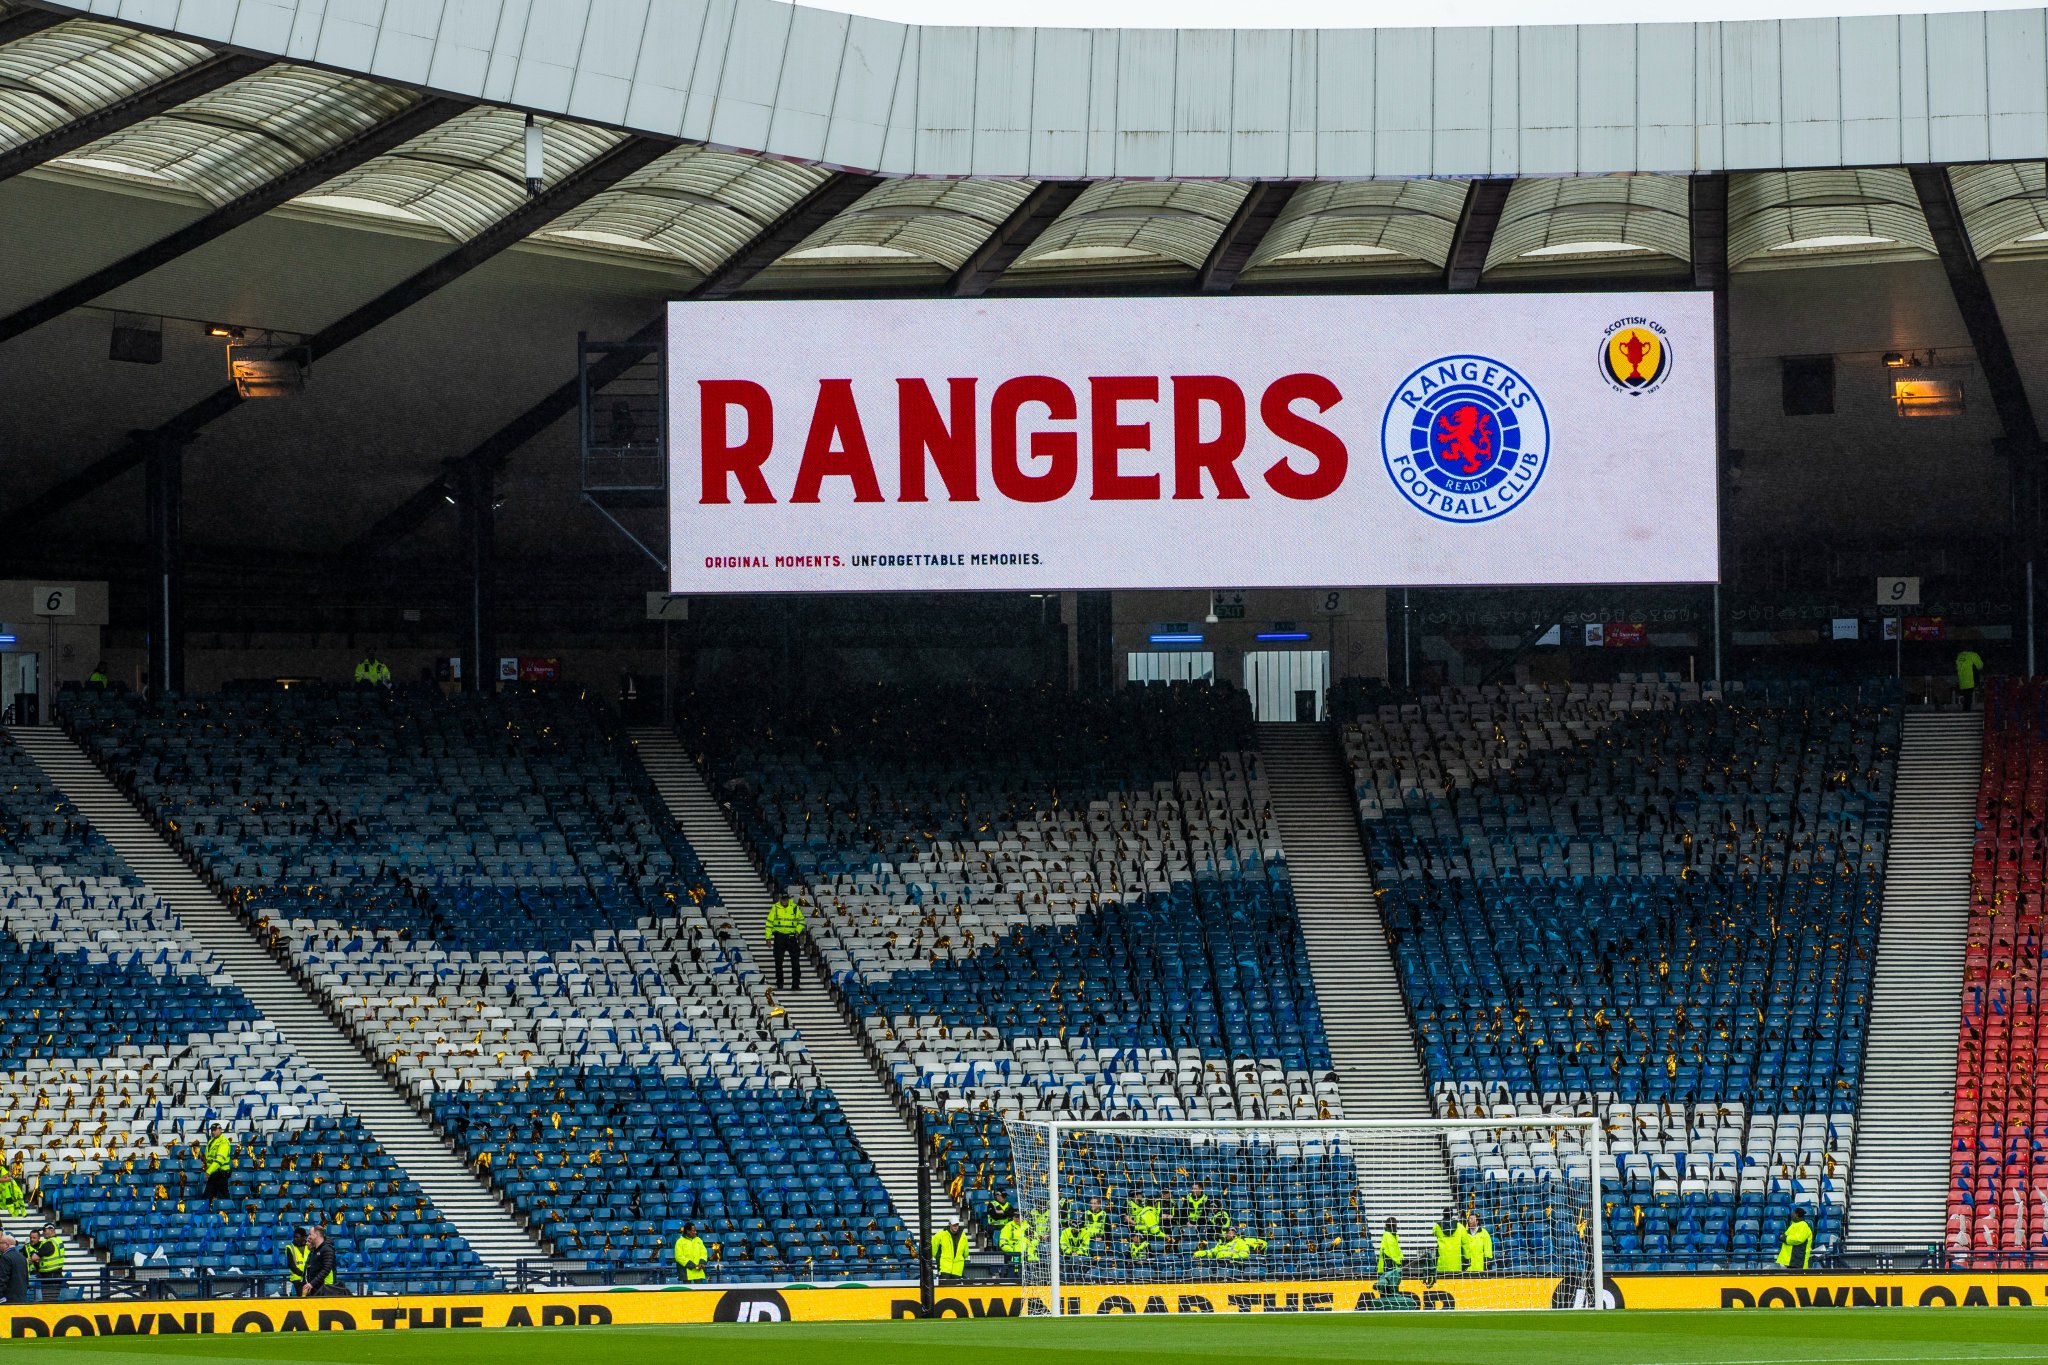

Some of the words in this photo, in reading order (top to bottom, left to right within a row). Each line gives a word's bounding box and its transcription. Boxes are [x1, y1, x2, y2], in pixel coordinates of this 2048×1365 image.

[1604, 316, 1647, 336] SCOTTISH
[1649, 320, 1667, 336] CUP
[1400, 361, 1531, 410] RANGERS
[1612, 384, 1625, 394] EST
[697, 373, 1349, 504] RANGERS
[1393, 454, 1497, 515] FOOTBALL
[1497, 452, 1539, 502] CLUB
[1445, 477, 1489, 493] READY
[705, 555, 770, 569] ORIGINAL
[774, 555, 846, 568] MOMENTS.
[851, 554, 966, 567] UNFORGETTABLE
[970, 553, 1044, 566] MEMORIES.
[46, 591, 62, 610] 6
[1890, 581, 1907, 600] 9
[658, 595, 674, 615] 7
[1324, 591, 1340, 611] 8
[1216, 607, 1243, 617] EXIT
[371, 1306, 484, 1330] THE
